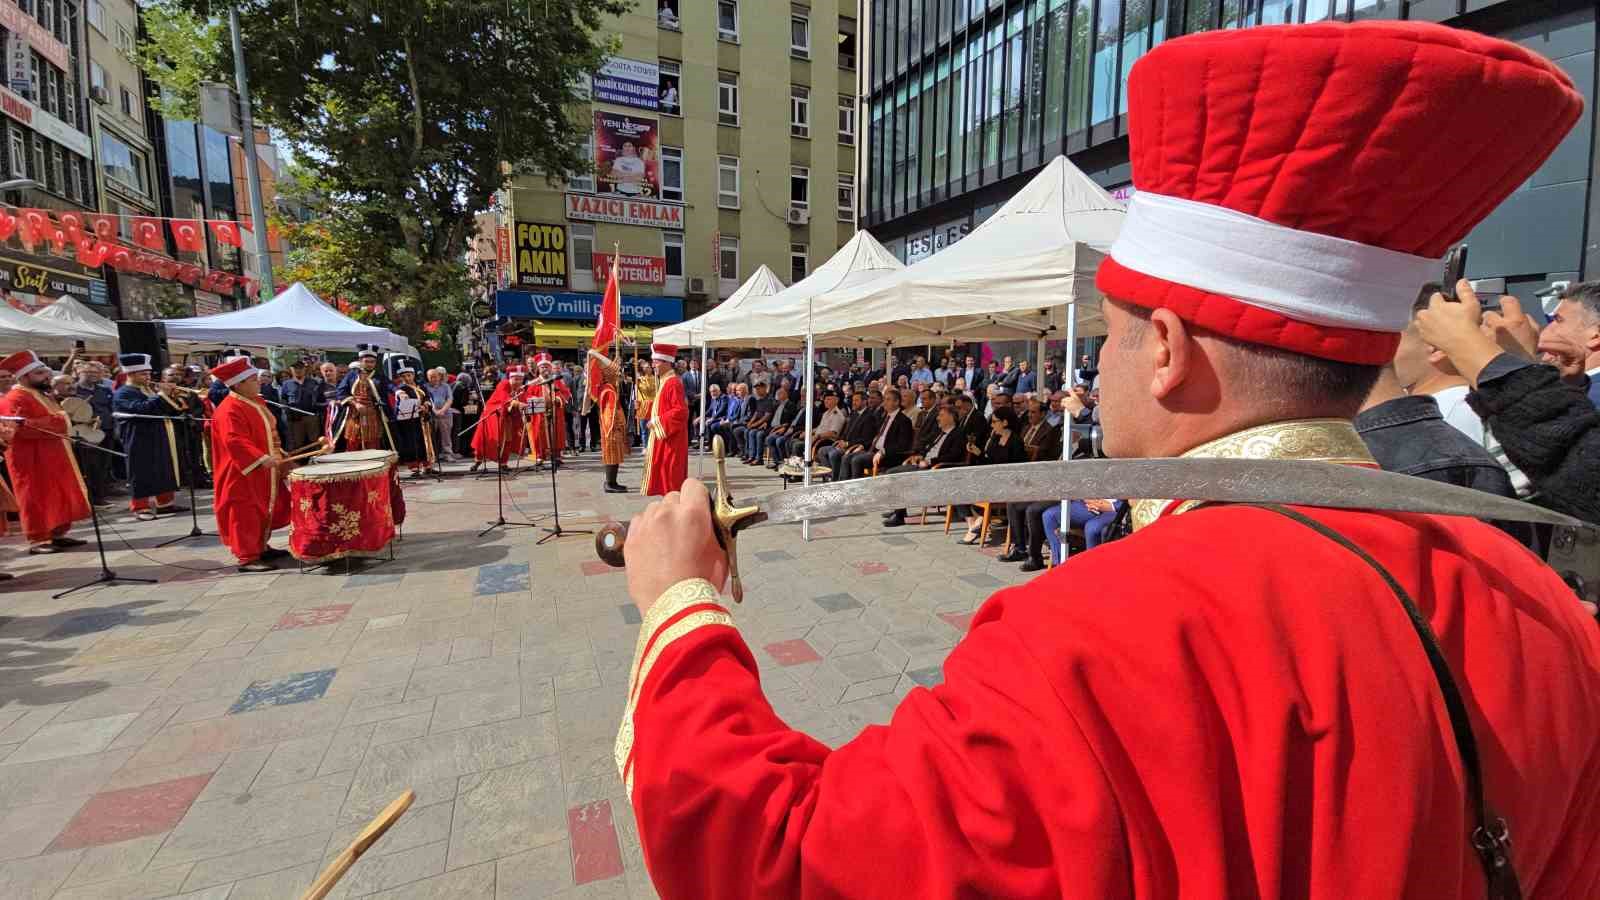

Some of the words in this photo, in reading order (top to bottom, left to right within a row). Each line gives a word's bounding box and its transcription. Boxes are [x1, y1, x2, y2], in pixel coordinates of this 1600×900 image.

[570, 195, 624, 216] YAZICI
[630, 203, 681, 222] EMLAK
[517, 223, 565, 250] FOTO
[519, 249, 565, 275] AKIN
[558, 299, 591, 314] milli
